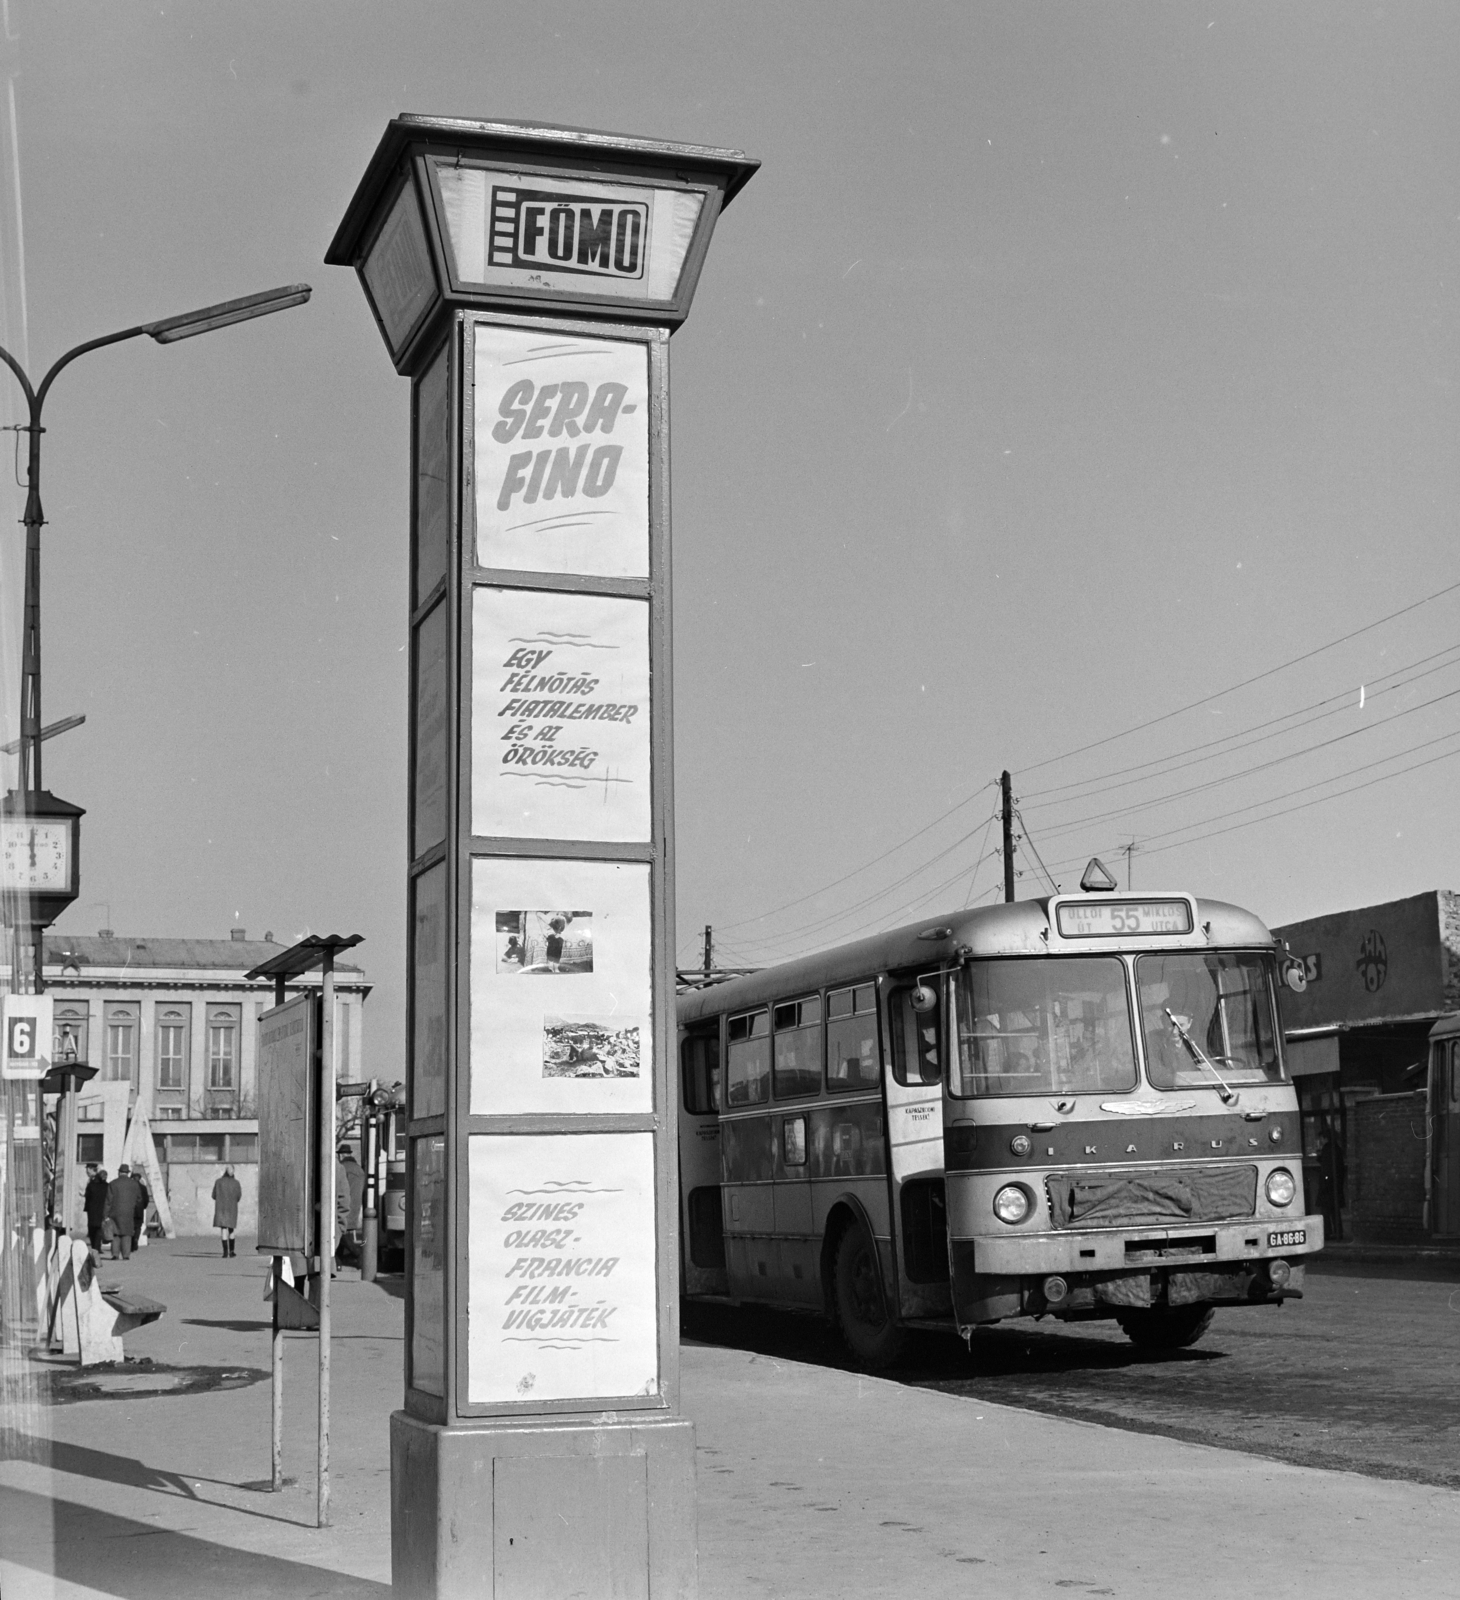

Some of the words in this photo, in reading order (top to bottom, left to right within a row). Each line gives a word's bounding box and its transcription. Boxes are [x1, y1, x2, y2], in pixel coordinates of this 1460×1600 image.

[491, 378, 638, 445] SERA-
[496, 442, 625, 512] FINO
[502, 647, 553, 670] EGY
[497, 698, 639, 725] FIATALEMBER
[500, 718, 534, 741] ÉS
[532, 725, 564, 742] AZ
[501, 742, 599, 770] ÖRÖKSÉG
[1110, 907, 1141, 932] 55
[13, 1022, 31, 1054] 6
[504, 1256, 621, 1280] FRANCIA
[504, 1284, 579, 1306] FILM-
